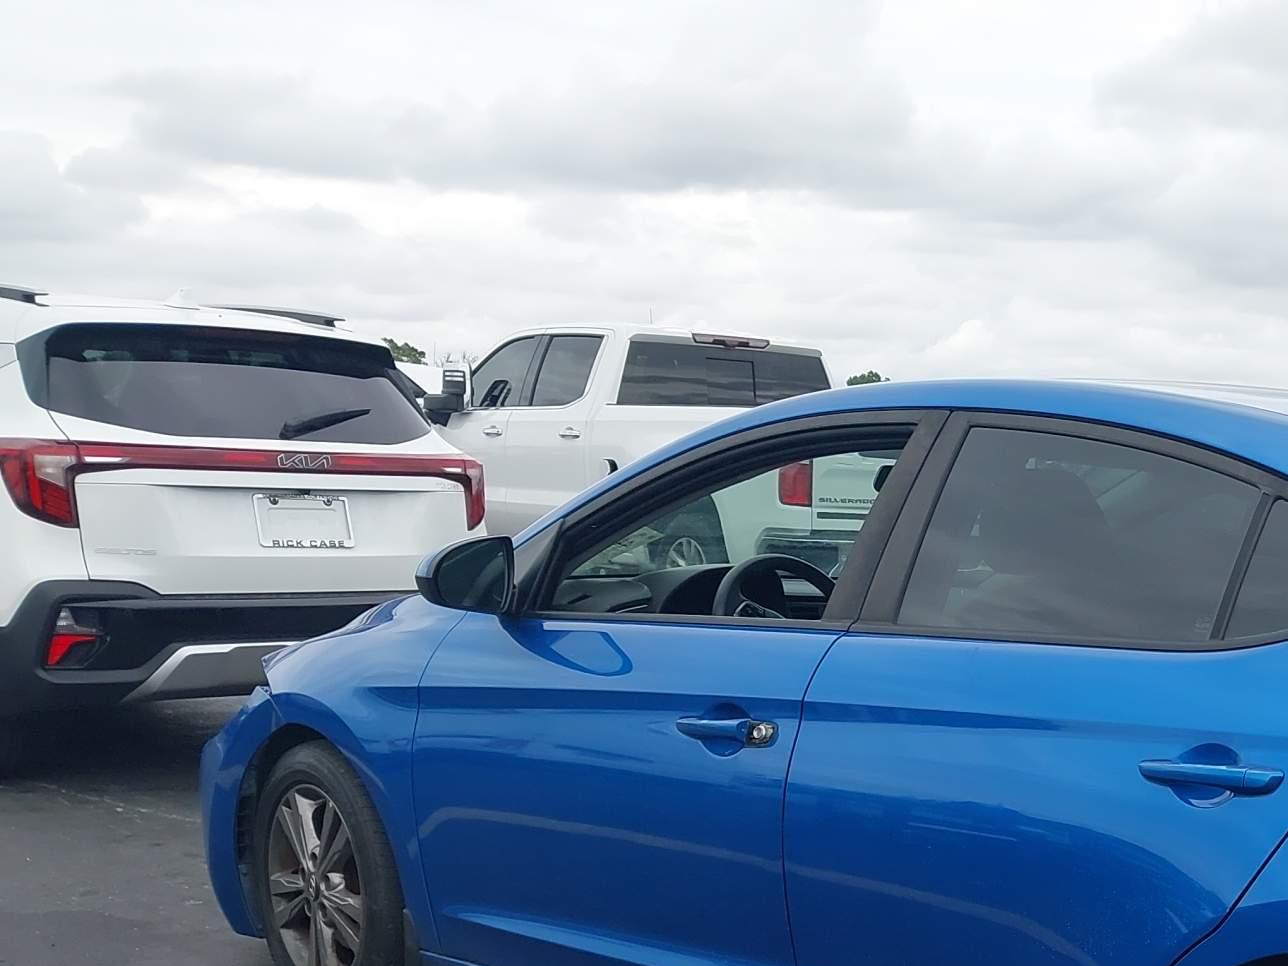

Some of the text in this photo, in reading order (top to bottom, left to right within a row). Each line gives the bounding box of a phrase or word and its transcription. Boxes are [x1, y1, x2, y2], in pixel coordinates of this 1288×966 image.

[278, 453, 332, 469] KIA
[272, 539, 345, 549] RICK CASE
